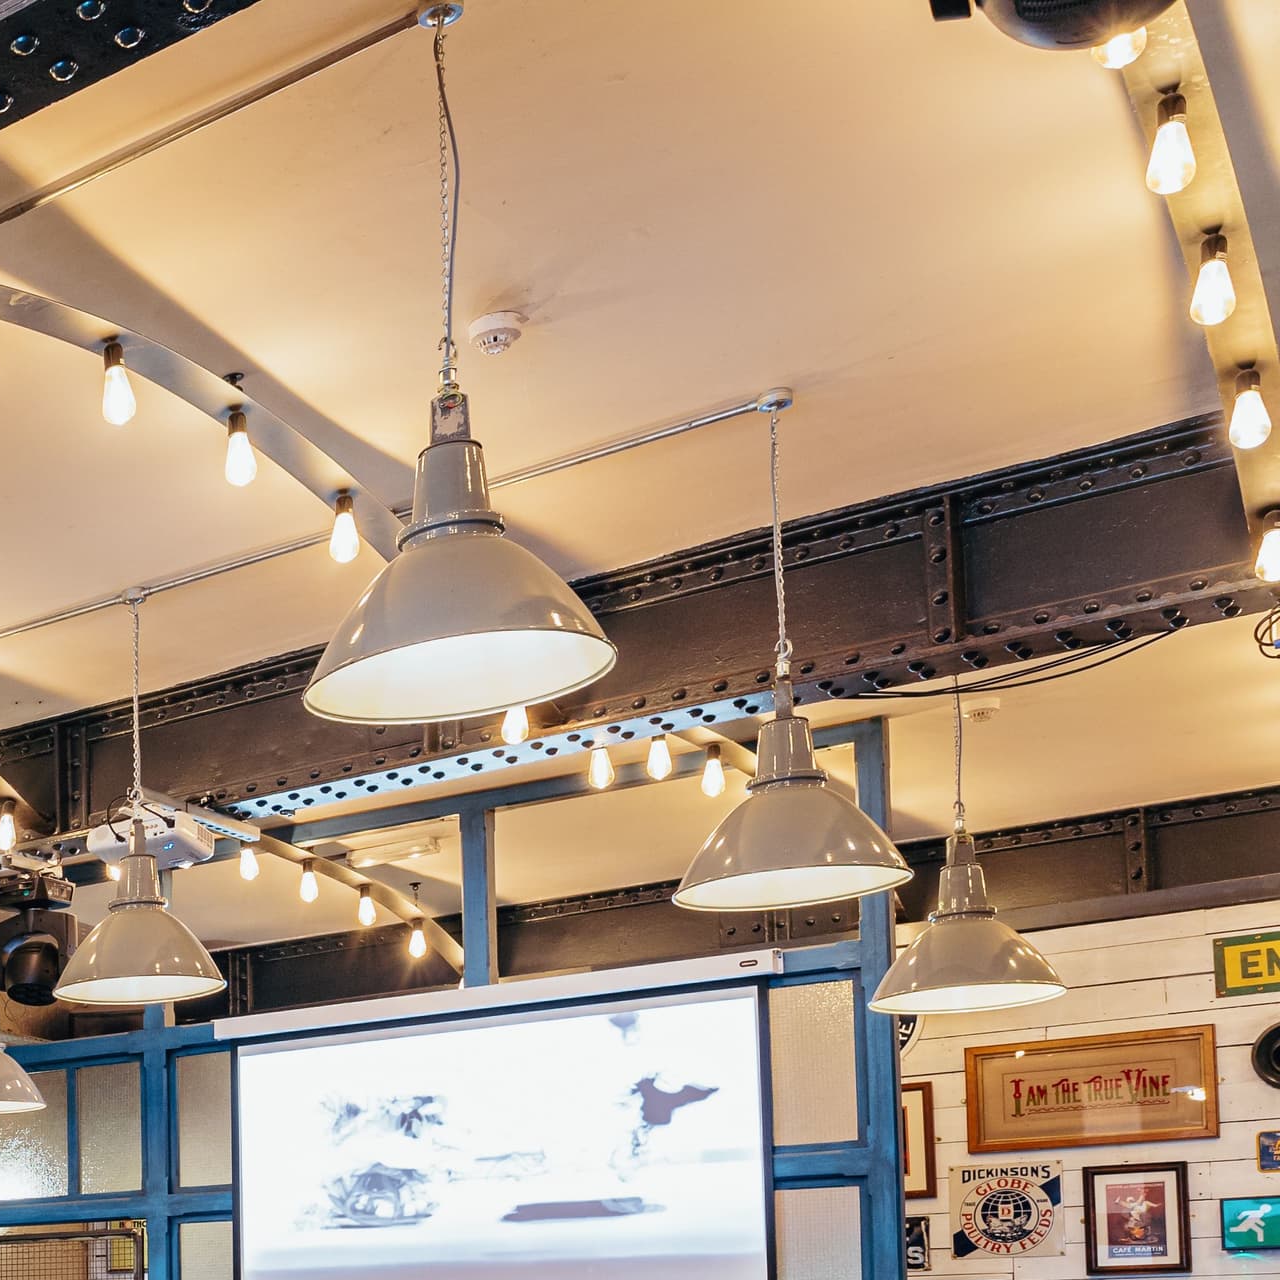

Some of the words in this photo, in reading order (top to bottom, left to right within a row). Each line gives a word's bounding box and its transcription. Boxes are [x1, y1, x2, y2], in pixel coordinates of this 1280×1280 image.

[1010, 1079, 1026, 1118] I
[1026, 1084, 1048, 1107] AM
[1052, 1078, 1082, 1105] THE
[1083, 1075, 1123, 1102] TRUE
[1120, 1068, 1171, 1104] VINE
[961, 1164, 1051, 1184] DICKINSON'S
[975, 1178, 1035, 1196] GLOBE
[962, 1213, 1013, 1254] POULTRY
[1019, 1208, 1053, 1250] FEEDS
[1134, 1245, 1164, 1253] MARTIN
